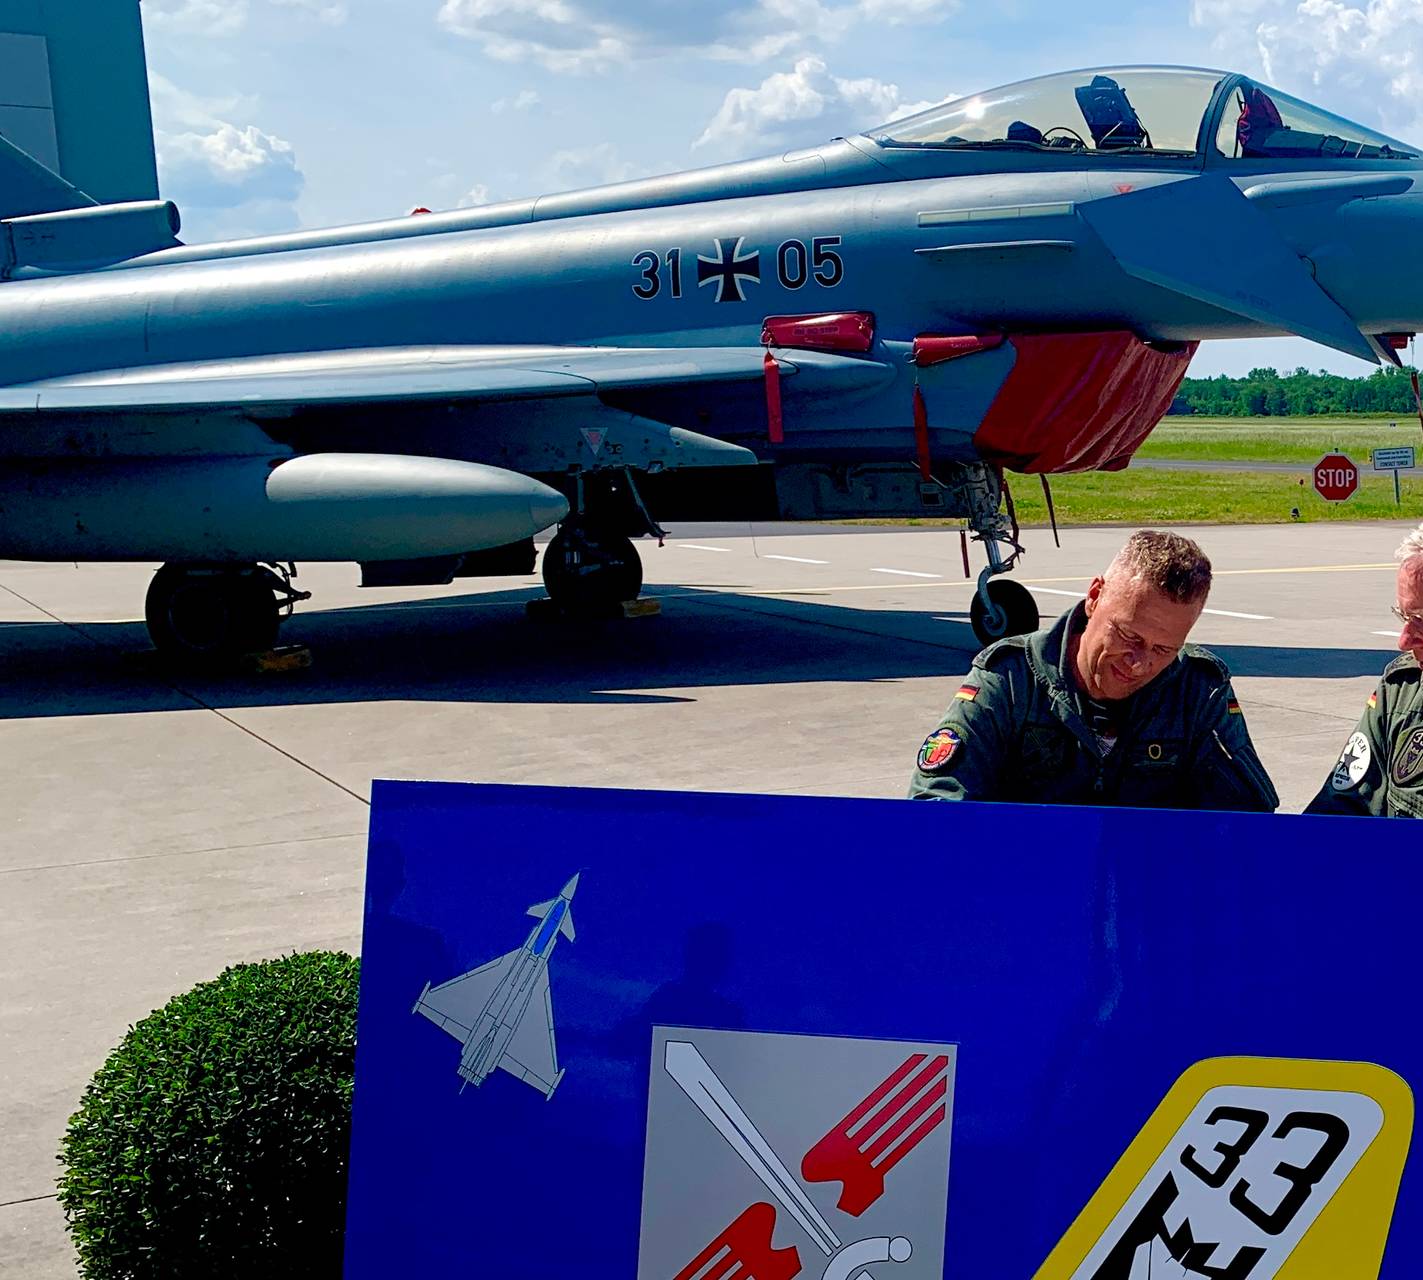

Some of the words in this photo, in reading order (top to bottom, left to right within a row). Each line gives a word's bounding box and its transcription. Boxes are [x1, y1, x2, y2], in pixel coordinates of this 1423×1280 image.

[631, 247, 682, 300] 31
[776, 235, 844, 290] 05
[1317, 468, 1355, 488] STOP
[1179, 1105, 1350, 1236] 33
